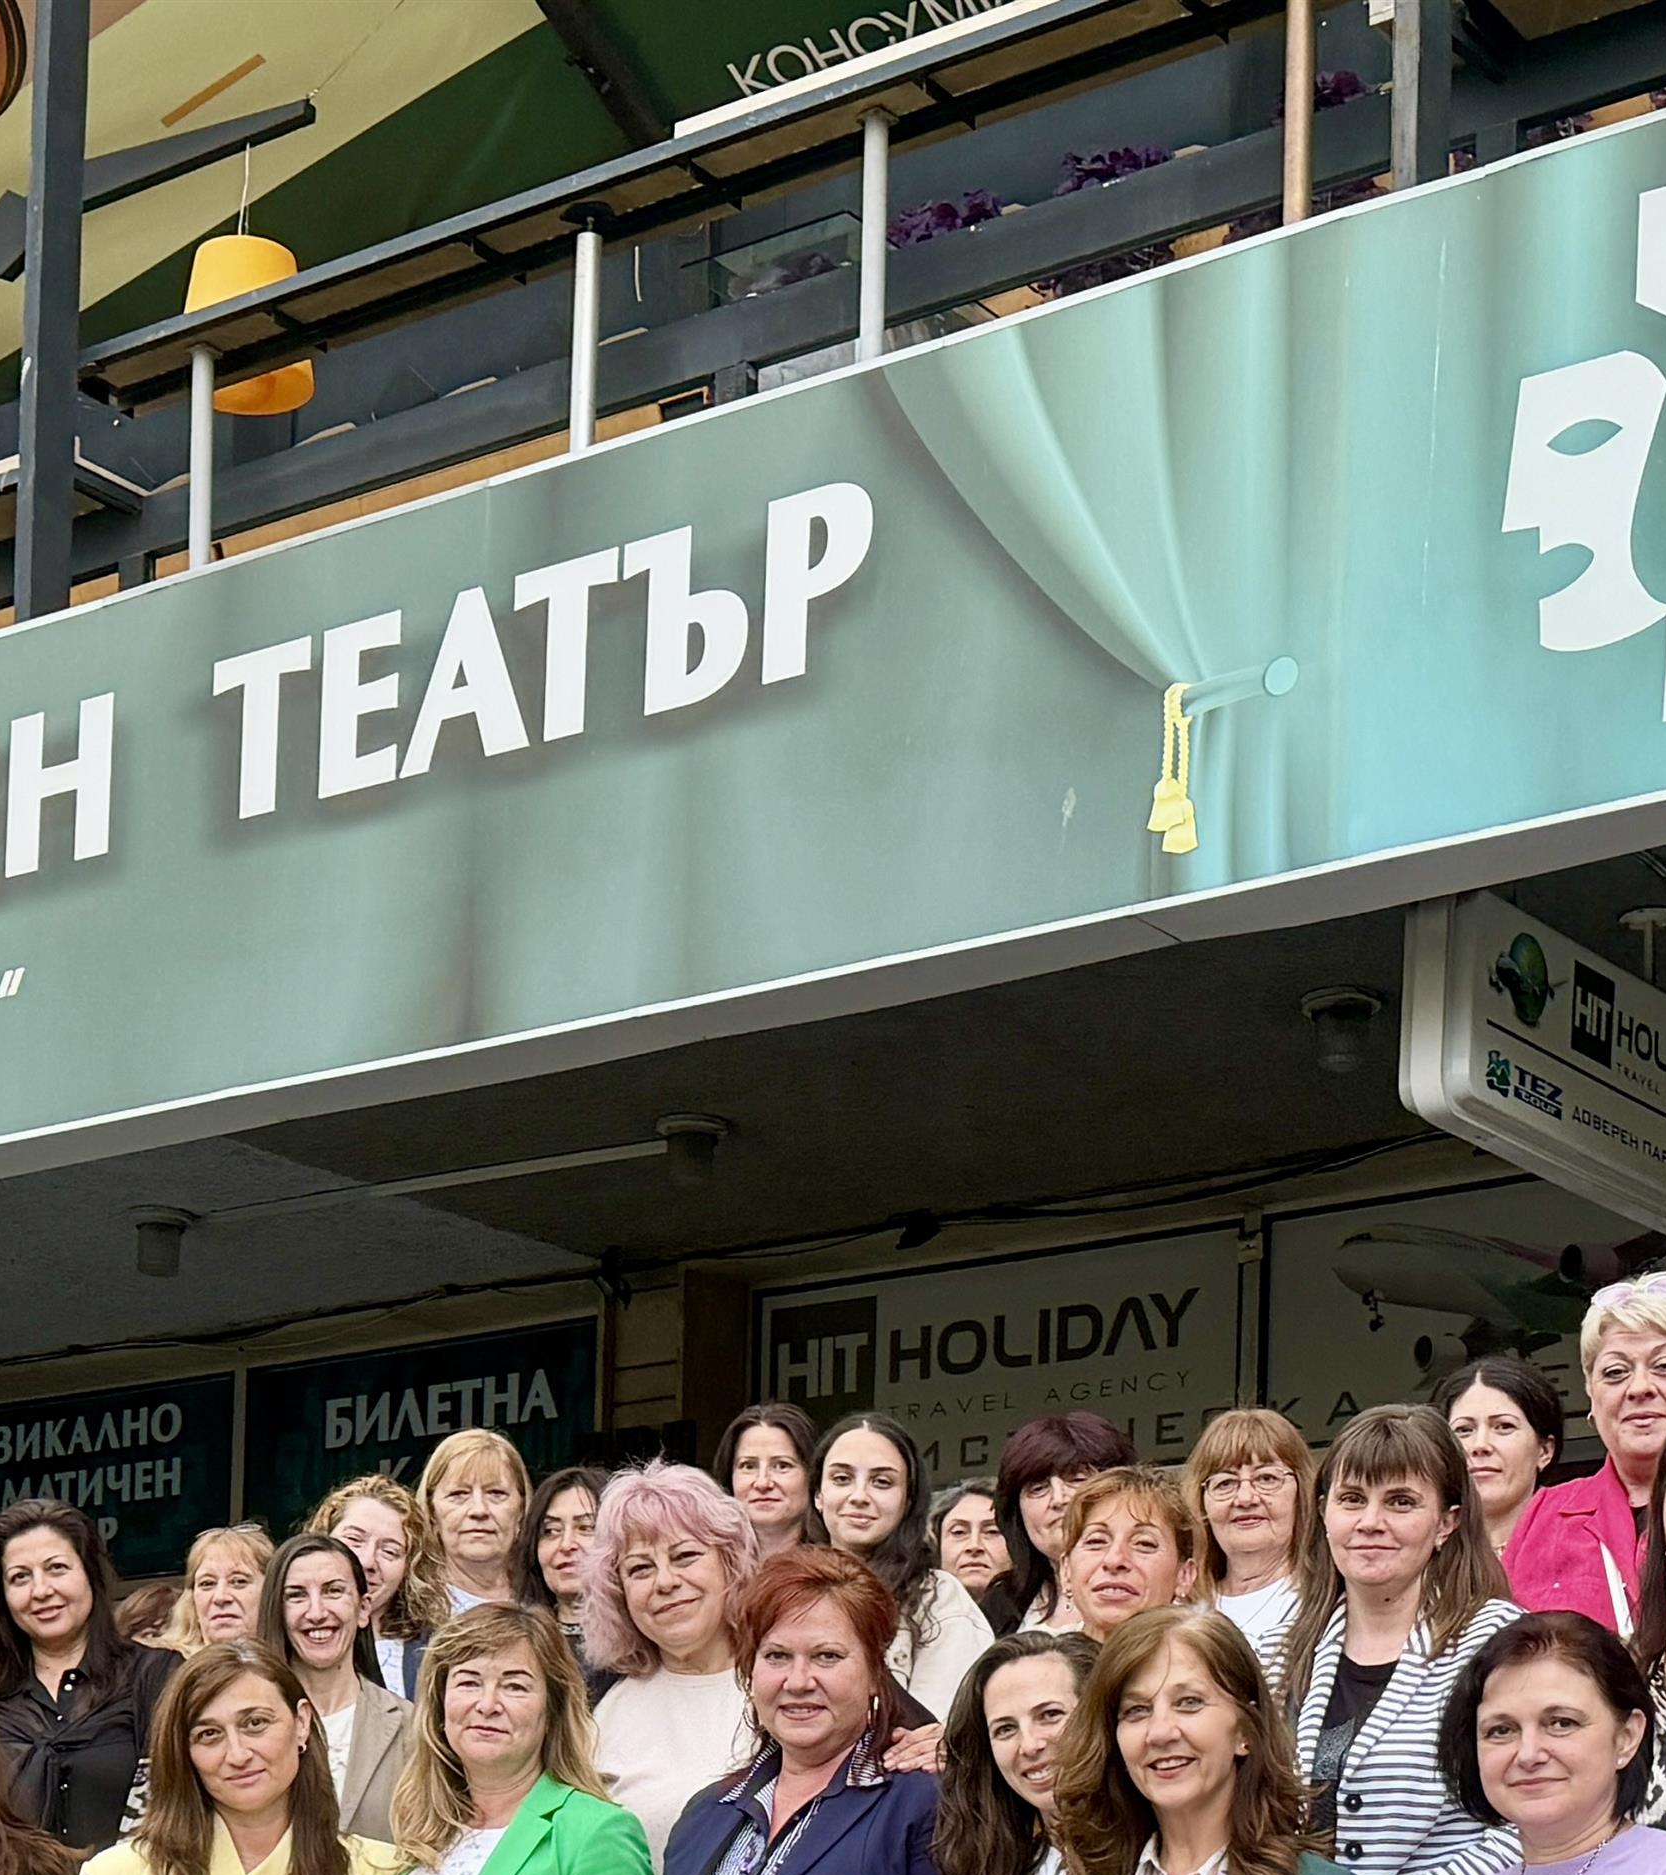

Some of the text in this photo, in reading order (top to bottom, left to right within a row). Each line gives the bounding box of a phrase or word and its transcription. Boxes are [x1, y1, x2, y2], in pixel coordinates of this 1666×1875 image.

[213, 482, 874, 820] ТЕАТЪР
[1574, 984, 1613, 1046] HIT
[1516, 1066, 1563, 1102] TEZ
[1615, 1062, 1660, 1095] TRAVEL
[1572, 1106, 1638, 1150] ДОВЕРЕН
[776, 1287, 1200, 1400] HIT HOLIDAY
[324, 1368, 559, 1450] БИЛЕТНА
[888, 1368, 1191, 1421] TRAVEL AGENCY
